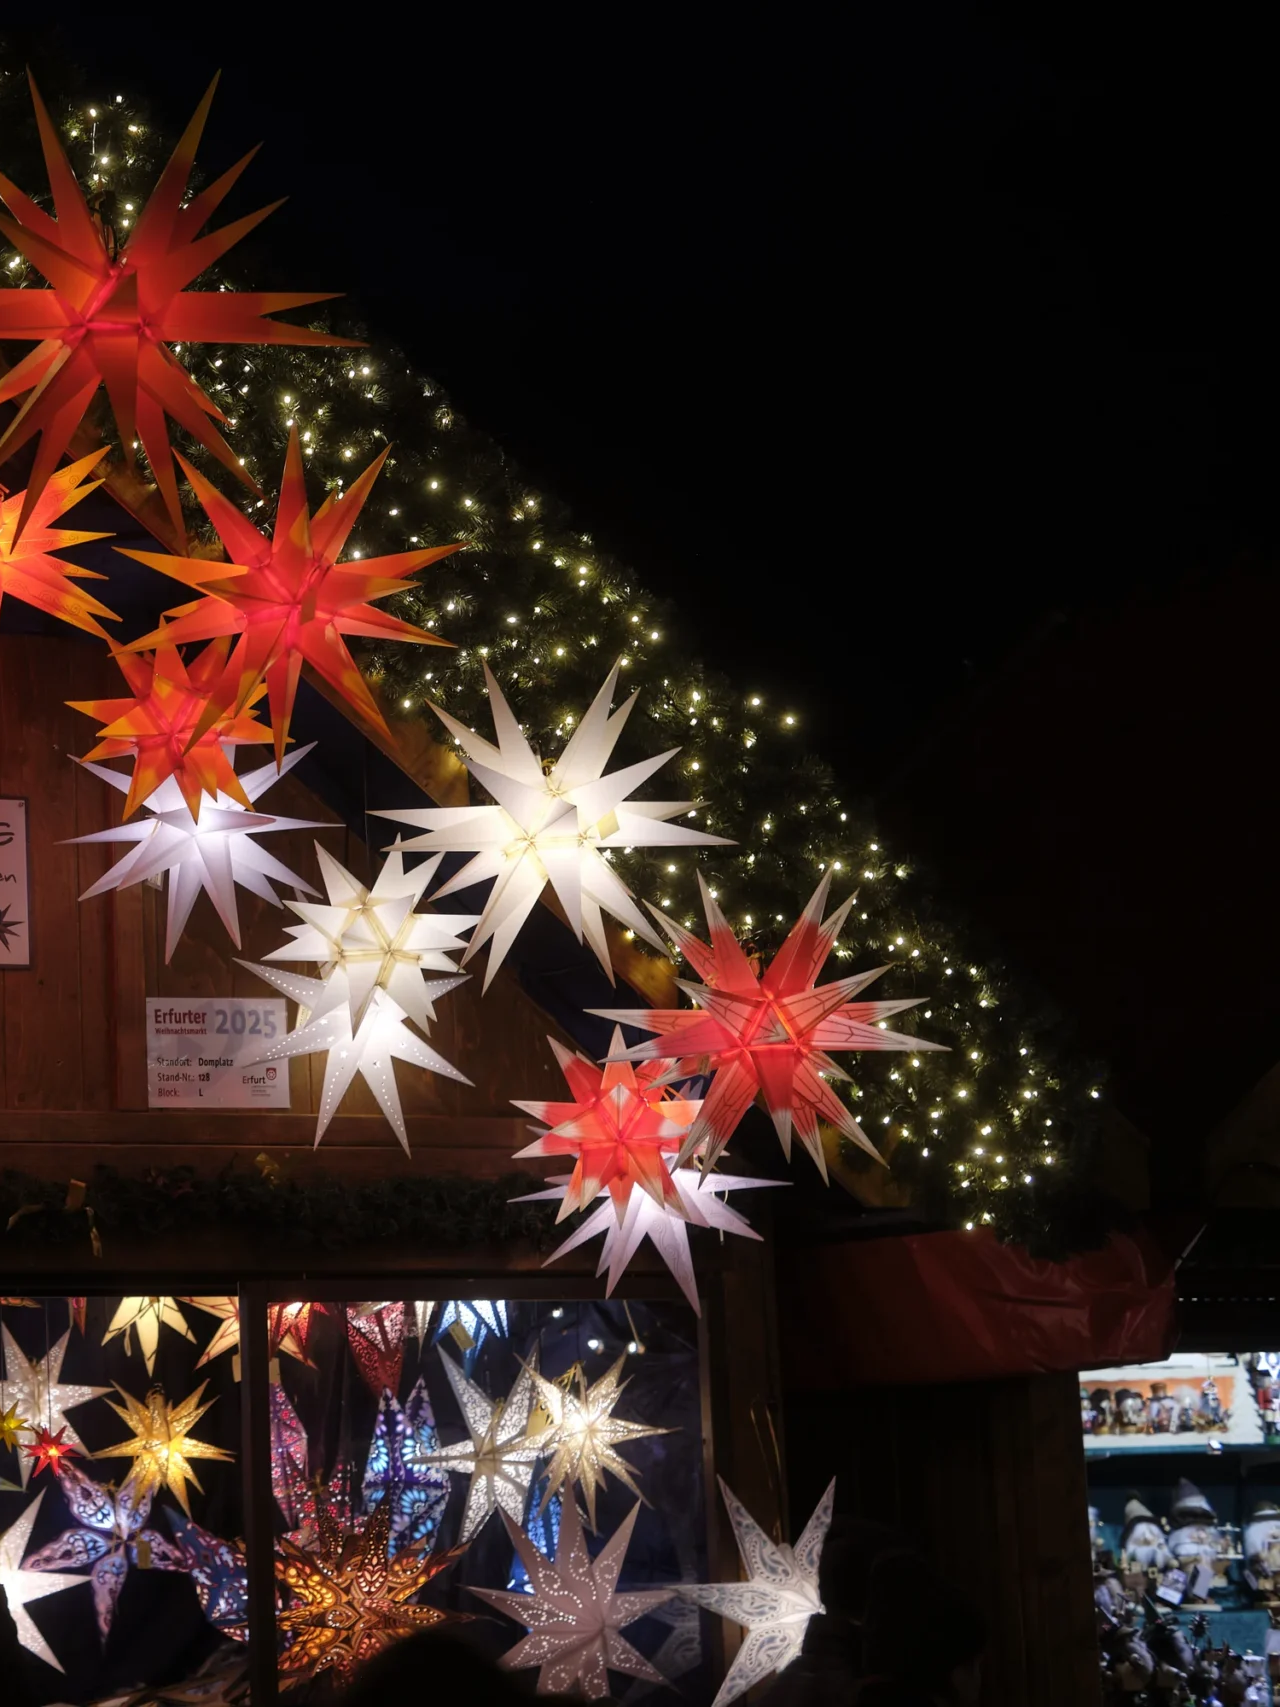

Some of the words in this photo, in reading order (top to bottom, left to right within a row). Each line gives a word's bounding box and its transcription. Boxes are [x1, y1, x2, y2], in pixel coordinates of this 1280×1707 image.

[154, 1008, 207, 1024] Erfurter
[215, 1009, 277, 1039] 2025
[155, 1027, 207, 1035] Weihnachtsmarkt
[157, 1058, 192, 1067] Standort:
[198, 1057, 234, 1068] Domplatz
[198, 1073, 211, 1082] 128
[242, 1075, 266, 1084] Erfurt
[158, 1088, 180, 1097] Block:
[198, 1088, 204, 1097] L
